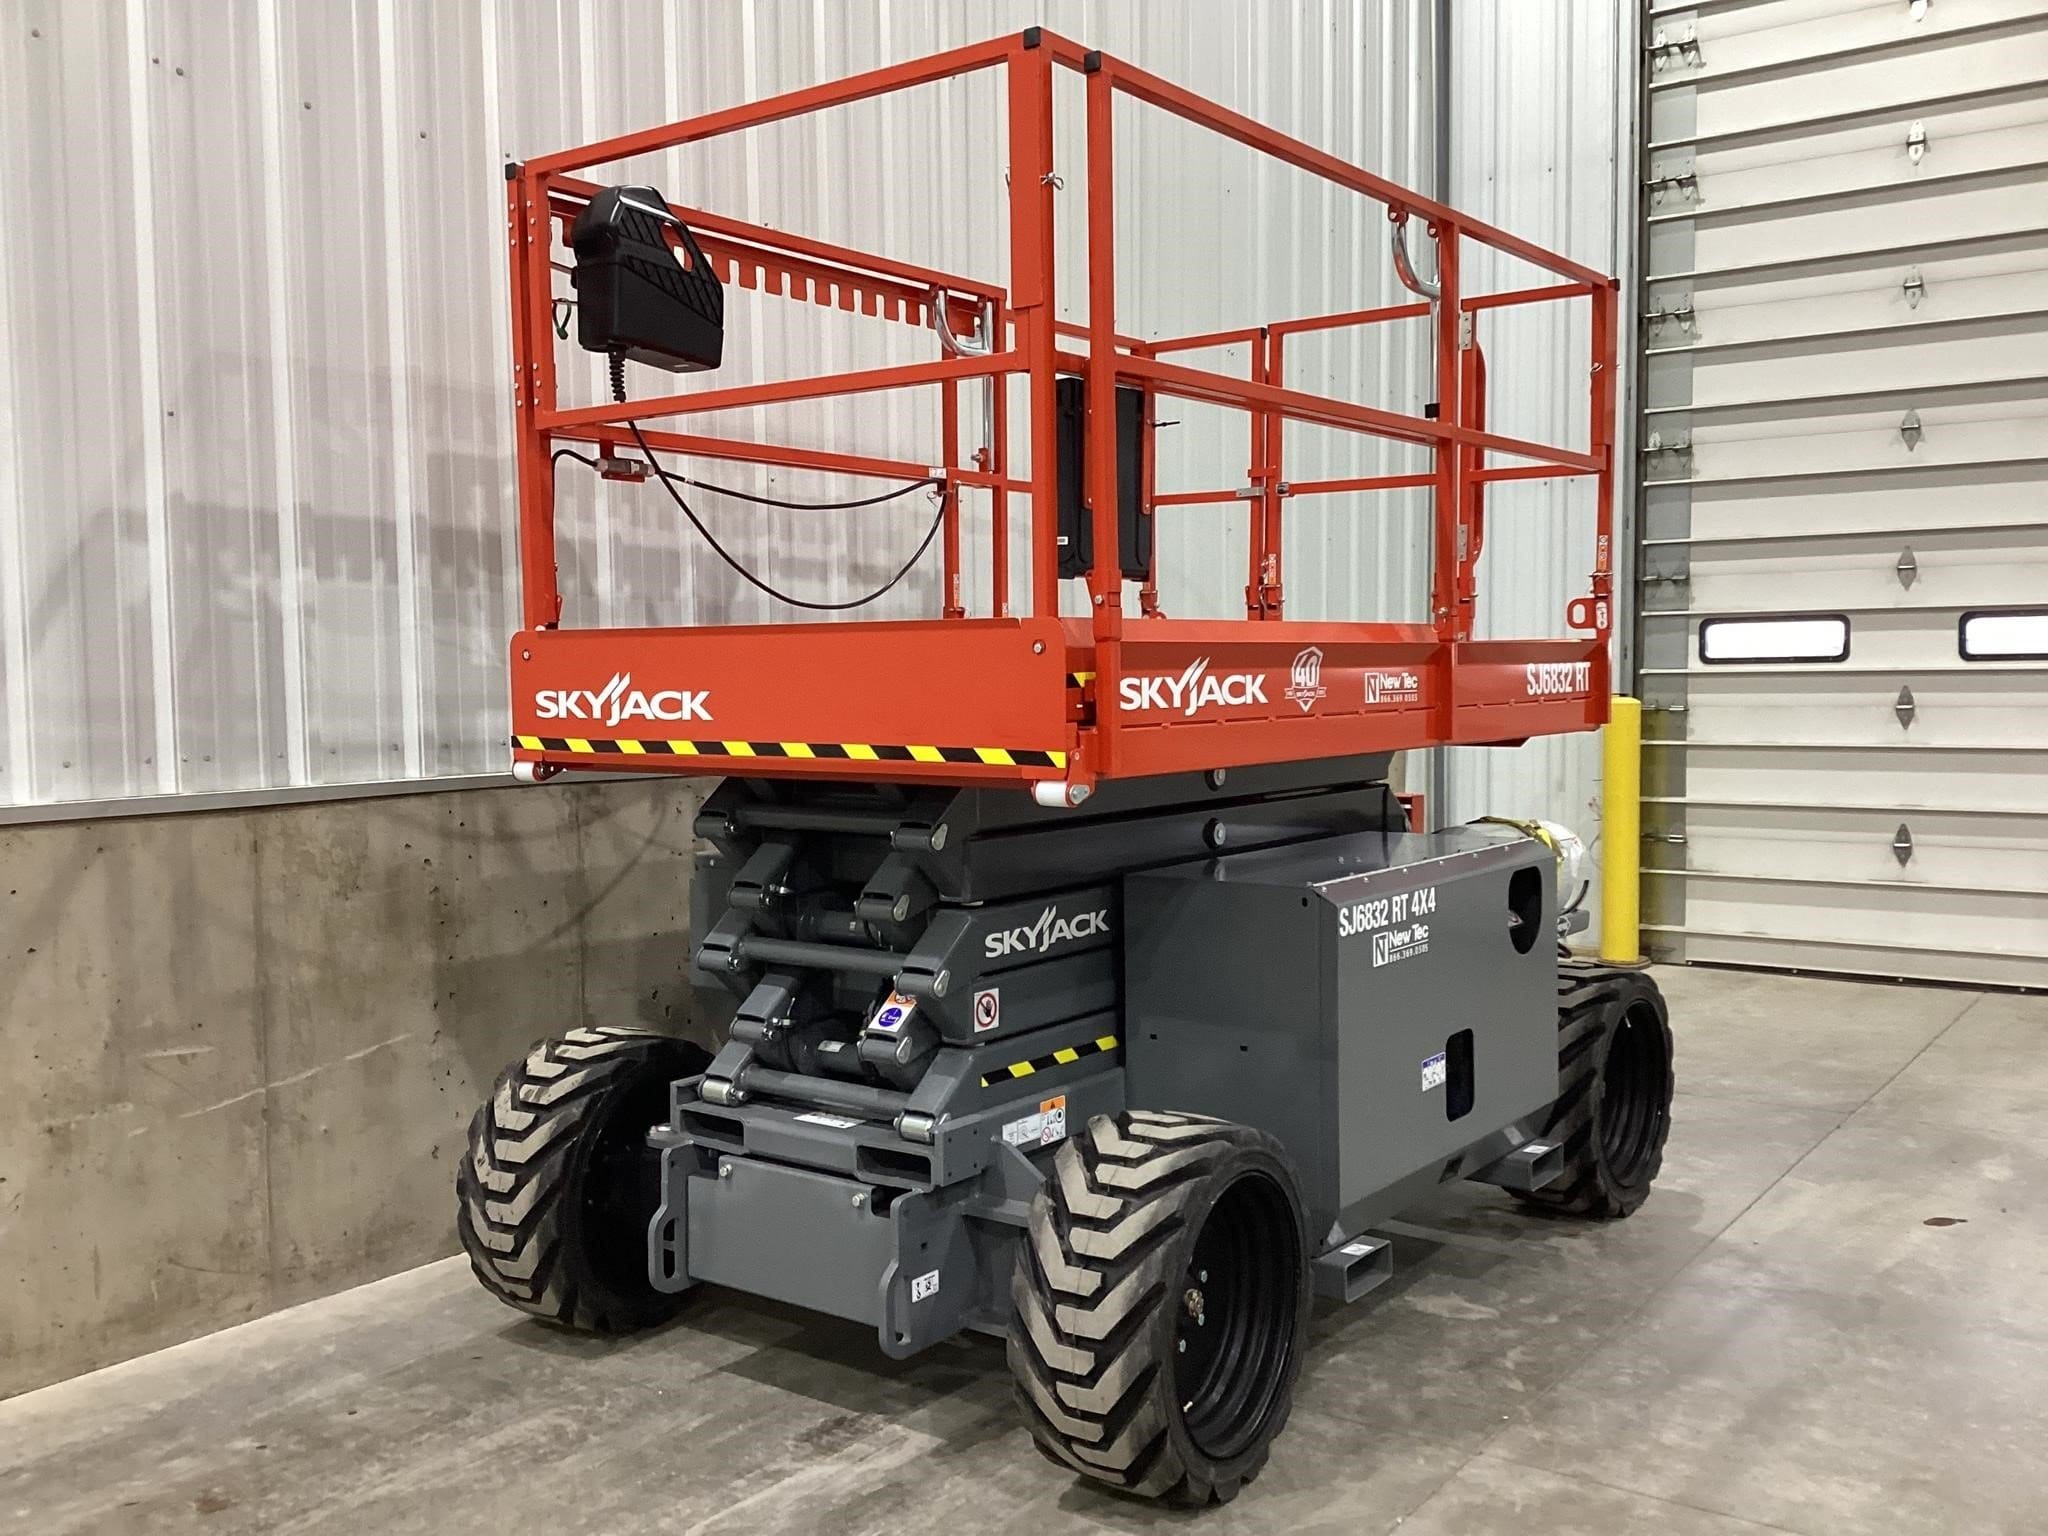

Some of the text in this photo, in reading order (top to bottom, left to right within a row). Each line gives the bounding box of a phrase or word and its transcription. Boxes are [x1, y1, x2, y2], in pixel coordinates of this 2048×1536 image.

[1119, 656, 1268, 716] SKYJACK
[1295, 654, 1318, 687] 40
[1380, 672, 1418, 689] New Tec
[1526, 661, 1591, 695] SJ6832 RT
[535, 671, 714, 727] SKYJACK
[984, 905, 1110, 959] SKYJACK
[1339, 887, 1436, 937] SJ6832 RT 4X4
[1390, 923, 1429, 948] New Tec
